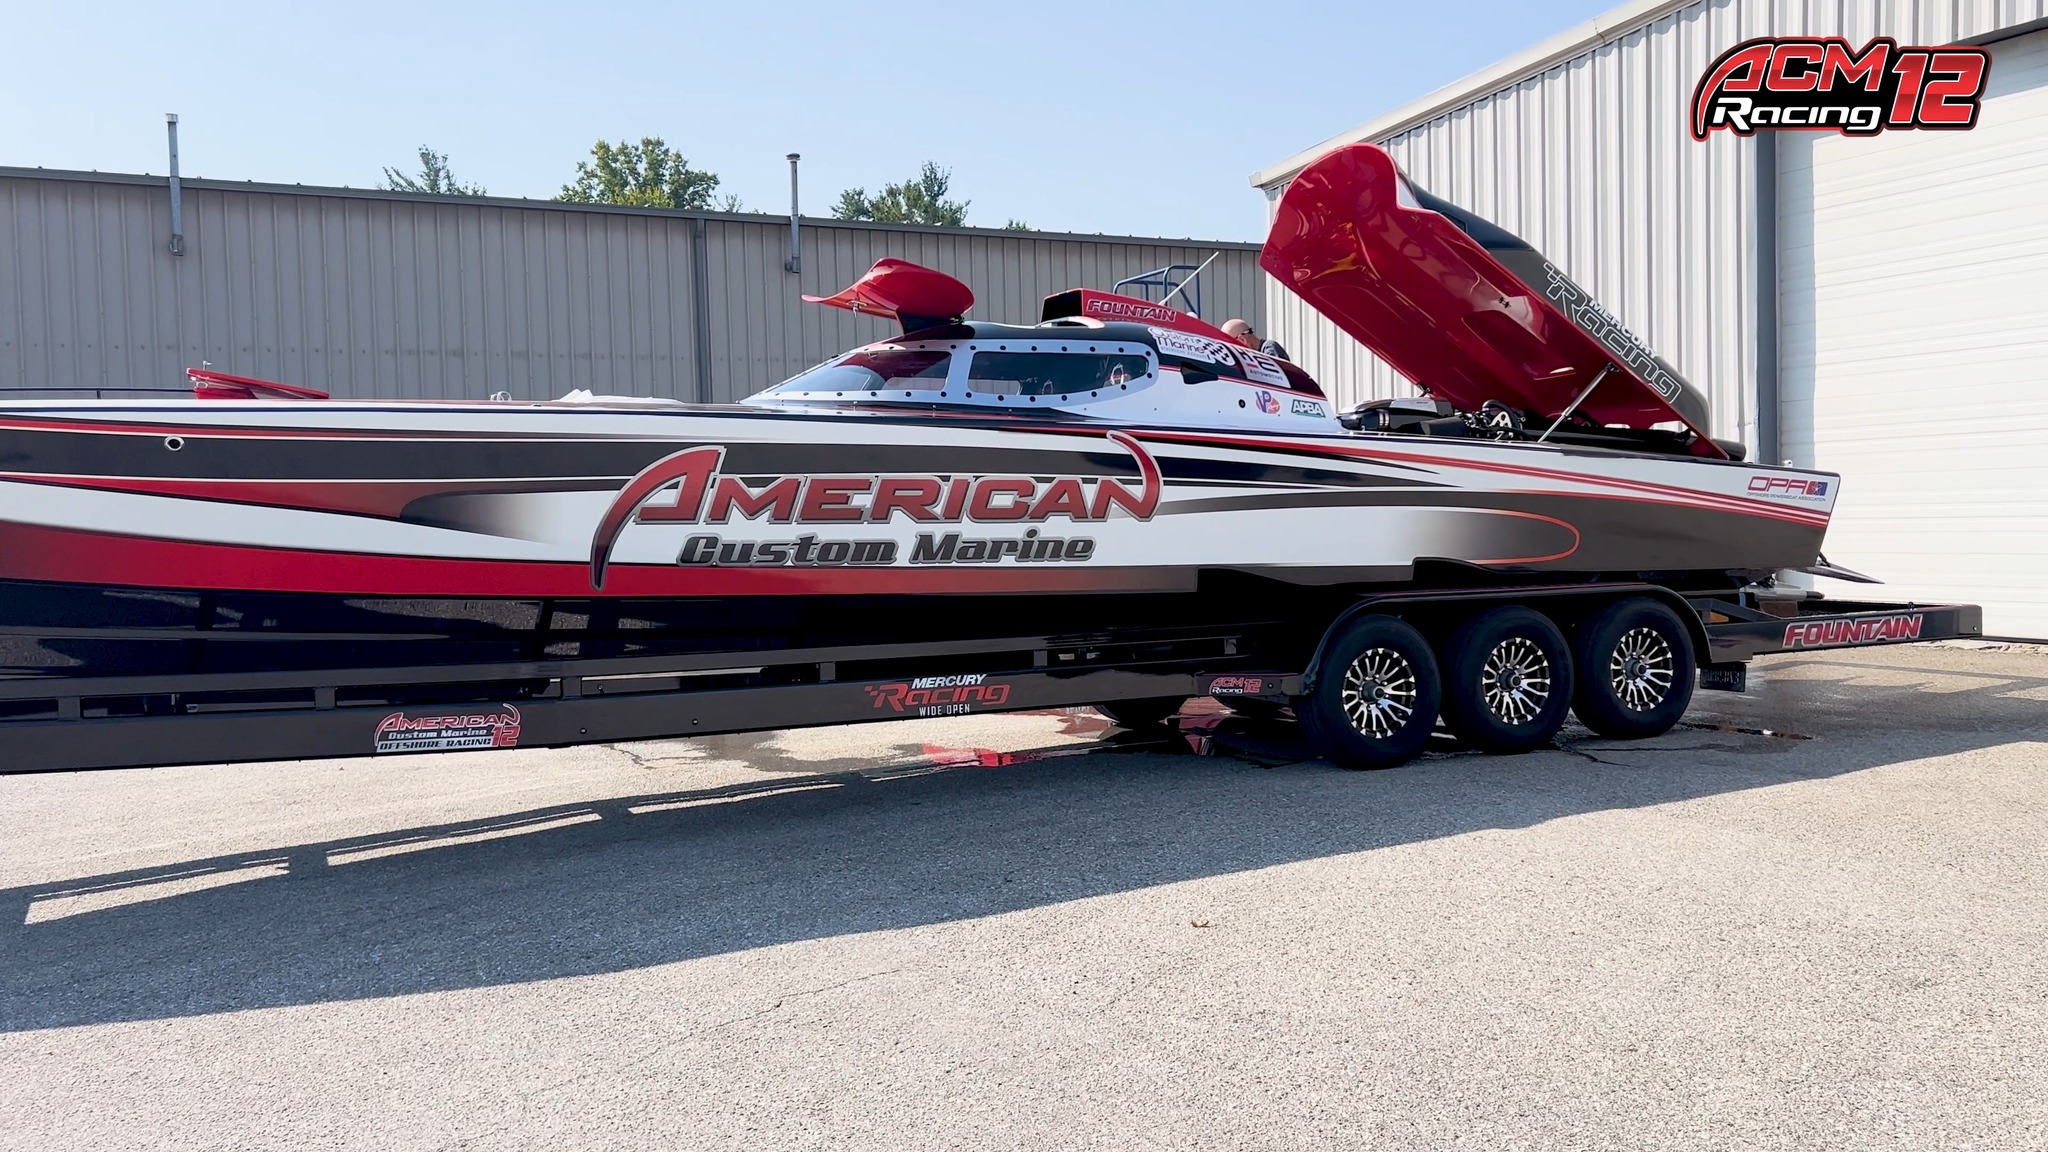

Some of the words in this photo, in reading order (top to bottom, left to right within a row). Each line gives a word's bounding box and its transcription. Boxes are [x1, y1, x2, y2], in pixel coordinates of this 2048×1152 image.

[1086, 299, 1177, 322] FOUNTAIN
[1545, 268, 1682, 404] Racing
[1589, 298, 1660, 360] MERCURY
[1292, 400, 1324, 416] APBA
[1747, 475, 1808, 495] OPA
[589, 430, 1162, 591] AMERICAN
[675, 531, 899, 567] Custom
[909, 526, 1097, 564] Marine
[1782, 613, 1924, 649] FOUNTAIN
[911, 673, 987, 689] MERCURY
[1209, 677, 1245, 695] ACM
[1244, 678, 1262, 694] 12
[866, 682, 1011, 712] Racing
[918, 705, 943, 717] WIDE
[946, 703, 970, 715] OPEN
[374, 703, 521, 746] AMERICAN
[388, 731, 438, 740] Custom
[440, 728, 487, 738] Marine
[490, 725, 521, 747] 12
[379, 740, 442, 750] OFFSHORE
[445, 737, 492, 748] RACING
